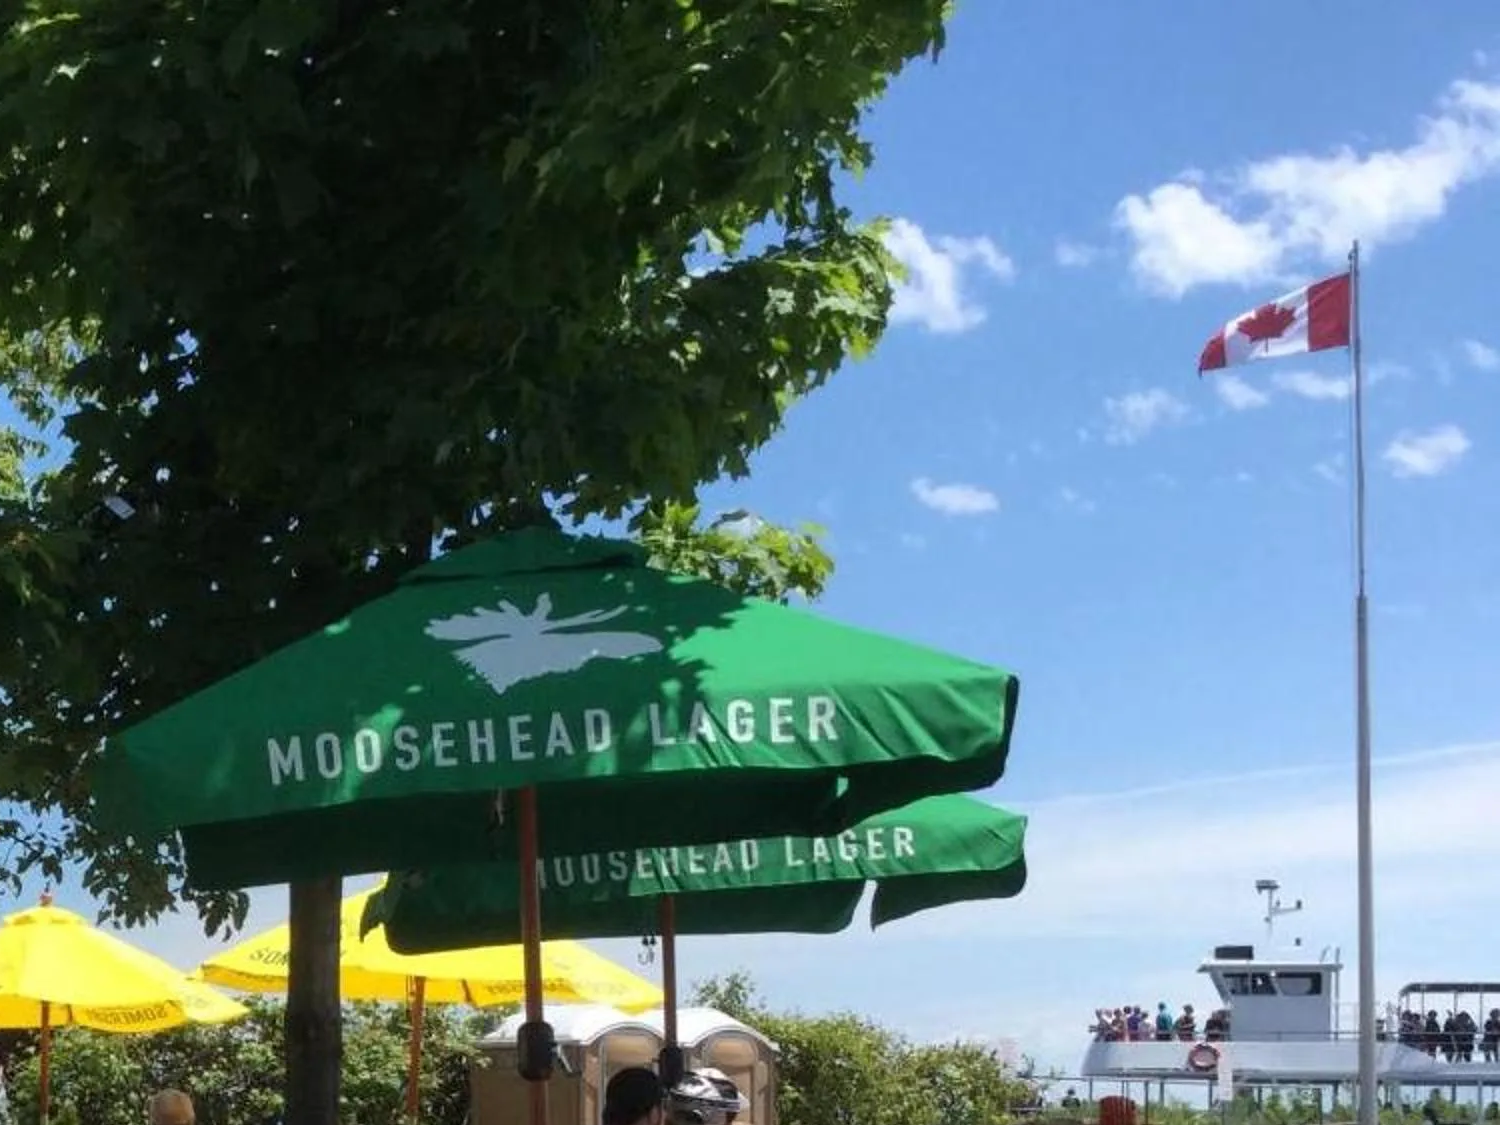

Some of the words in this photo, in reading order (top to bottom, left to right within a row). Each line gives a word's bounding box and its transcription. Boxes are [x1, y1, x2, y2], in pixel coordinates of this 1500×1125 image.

[267, 708, 611, 786] MOOSEHEAD
[649, 695, 839, 746] LAGER
[785, 826, 916, 867] LAGER
